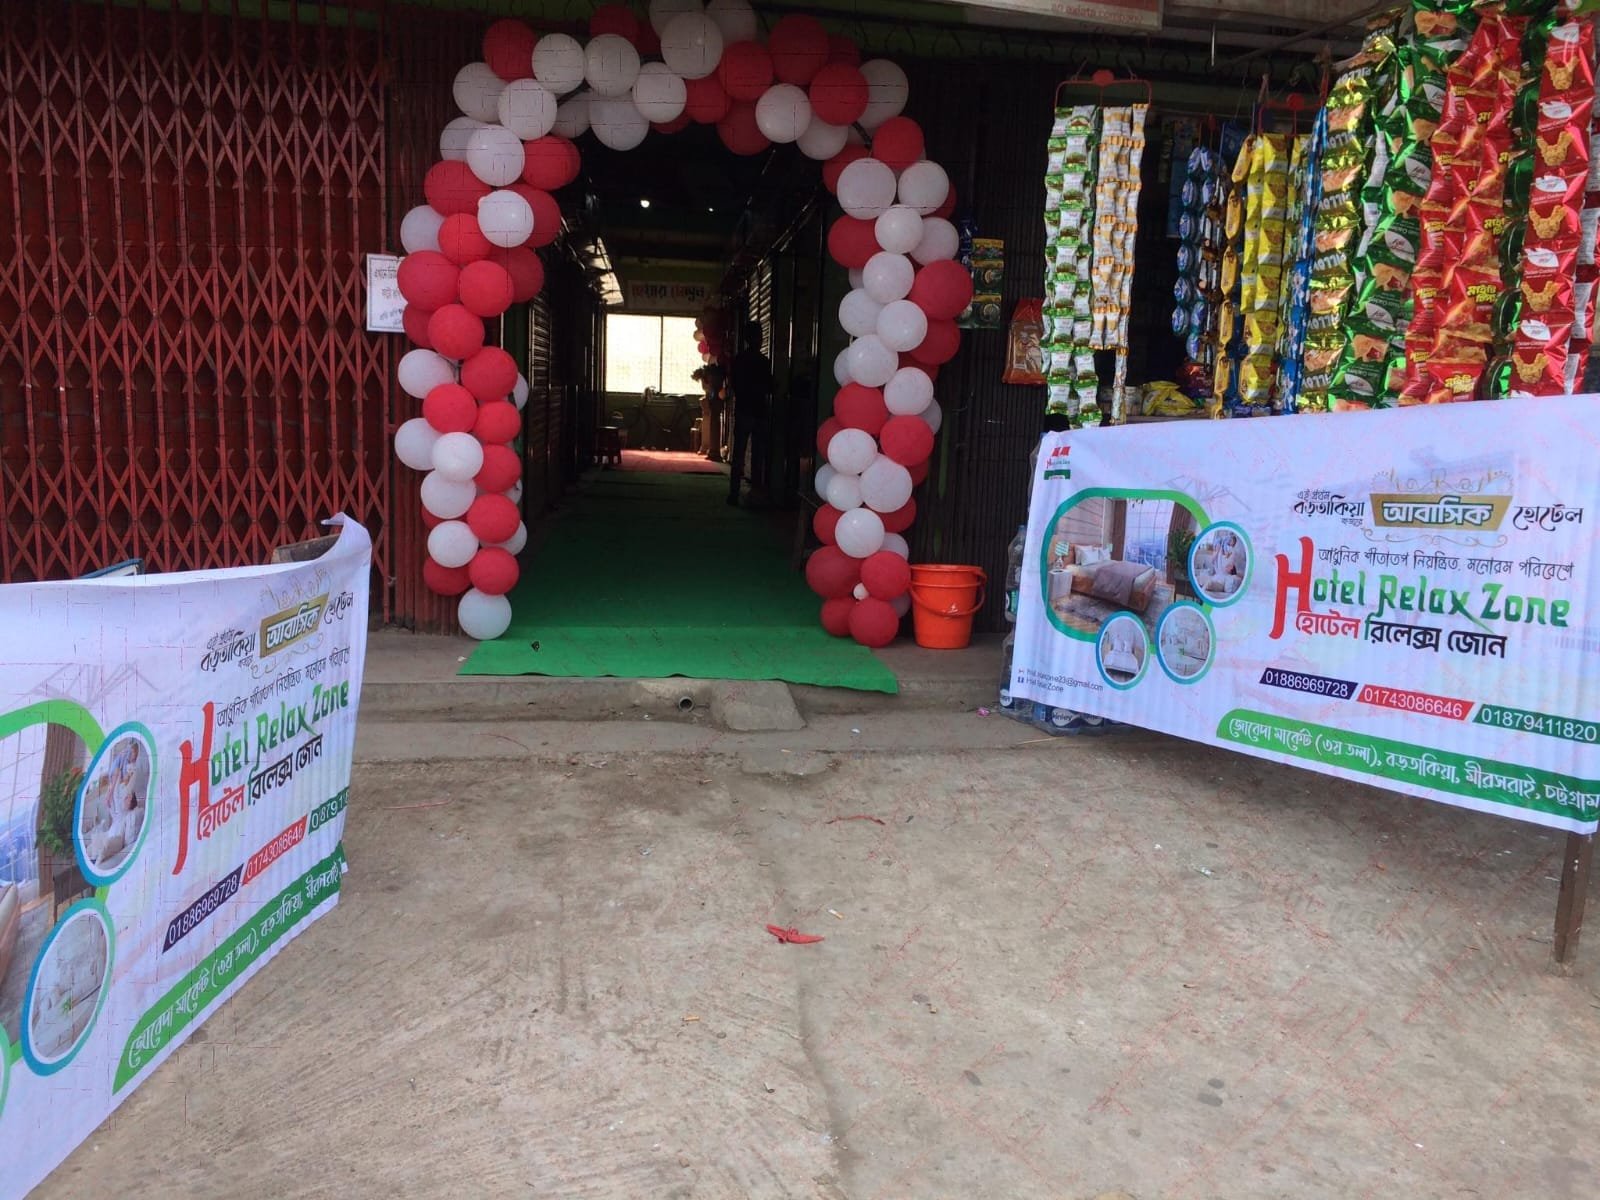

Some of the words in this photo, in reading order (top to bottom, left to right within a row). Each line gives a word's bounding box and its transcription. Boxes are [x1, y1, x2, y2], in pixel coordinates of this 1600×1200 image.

[1294, 494, 1365, 518] বড়তাকিয়া
[1382, 496, 1493, 526] আবাসিক
[1512, 503, 1583, 531] হোটেল
[1269, 536, 1366, 640] Hotel
[1376, 573, 1494, 634] Relax
[1480, 582, 1571, 628] Zone
[1318, 545, 1360, 566] আধুনিক
[1364, 547, 1410, 568] শীতাতপ
[1467, 557, 1513, 576] মনোরম
[1519, 556, 1575, 581] পরিবেশে
[266, 602, 321, 650] আবাসিক
[1296, 608, 1361, 641] হোটেল
[1364, 612, 1442, 653] রিলেক্স
[1448, 630, 1507, 659] জোন
[216, 696, 248, 727] আধুনিক
[1265, 669, 1349, 698] 01886969728
[1364, 686, 1463, 719] 01743086646
[1481, 706, 1597, 742] 01879411820
[172, 701, 249, 875] Hotel
[254, 701, 318, 772] Relax
[311, 680, 349, 724] Zone
[197, 784, 246, 840] হোটেল
[247, 752, 293, 806] রিলেক্স
[295, 733, 324, 772] জোন
[1274, 728, 1313, 751] মার্কেট
[1543, 780, 1600, 814] চট্টগ্রাম
[169, 874, 238, 945] 01886969728
[175, 968, 211, 1013] মার্কেট
